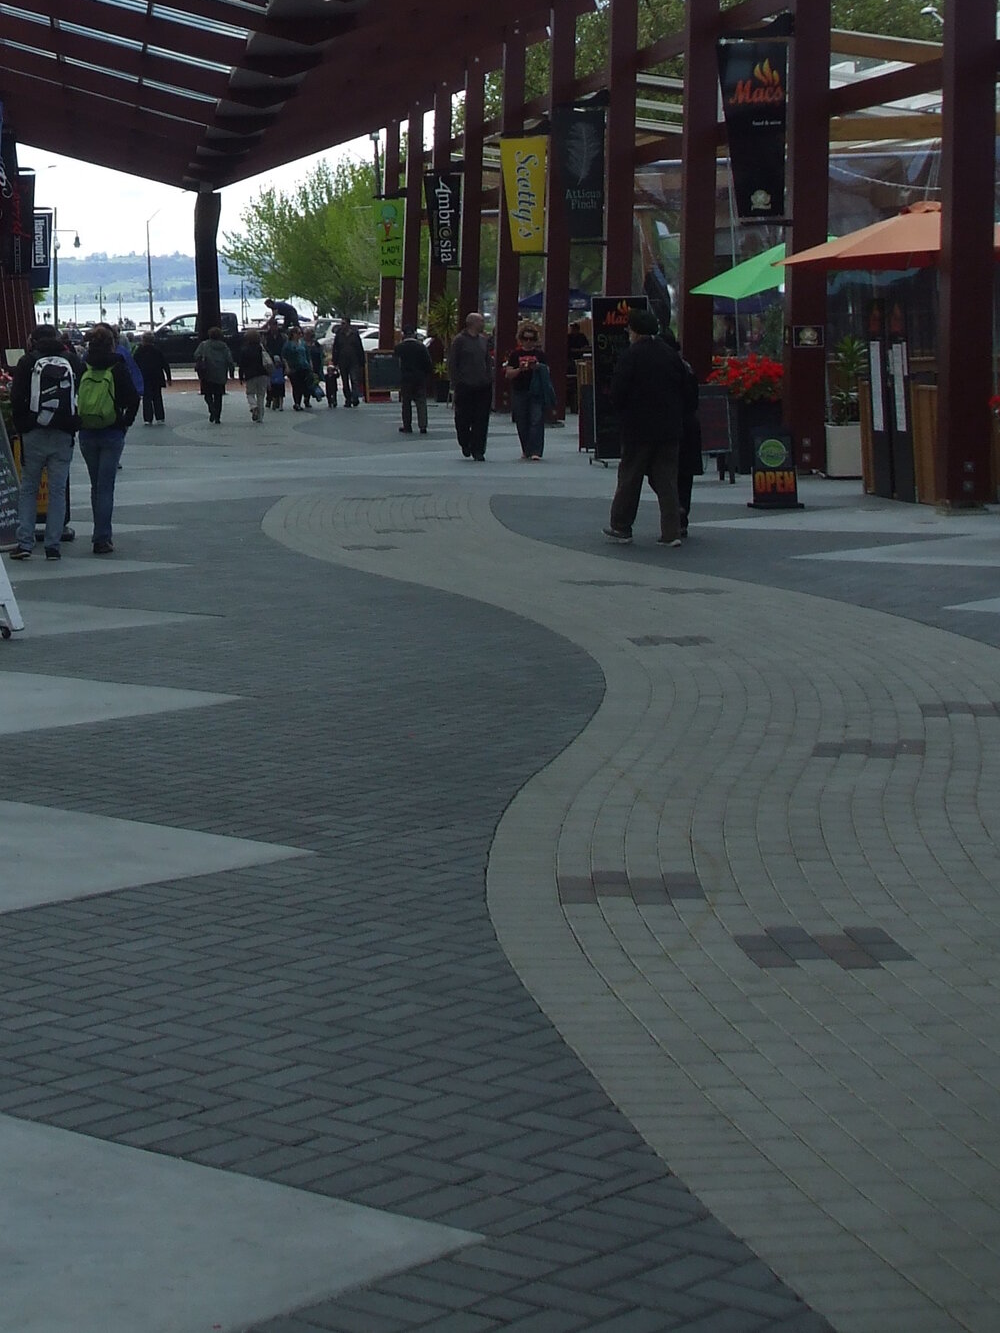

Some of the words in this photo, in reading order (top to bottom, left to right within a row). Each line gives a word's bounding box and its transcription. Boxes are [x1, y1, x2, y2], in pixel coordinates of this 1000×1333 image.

[434, 176, 456, 263] Ambrosia
[509, 149, 541, 239] Scotty's
[34, 219, 46, 265] Harcourts
[754, 471, 796, 494] OPEN
